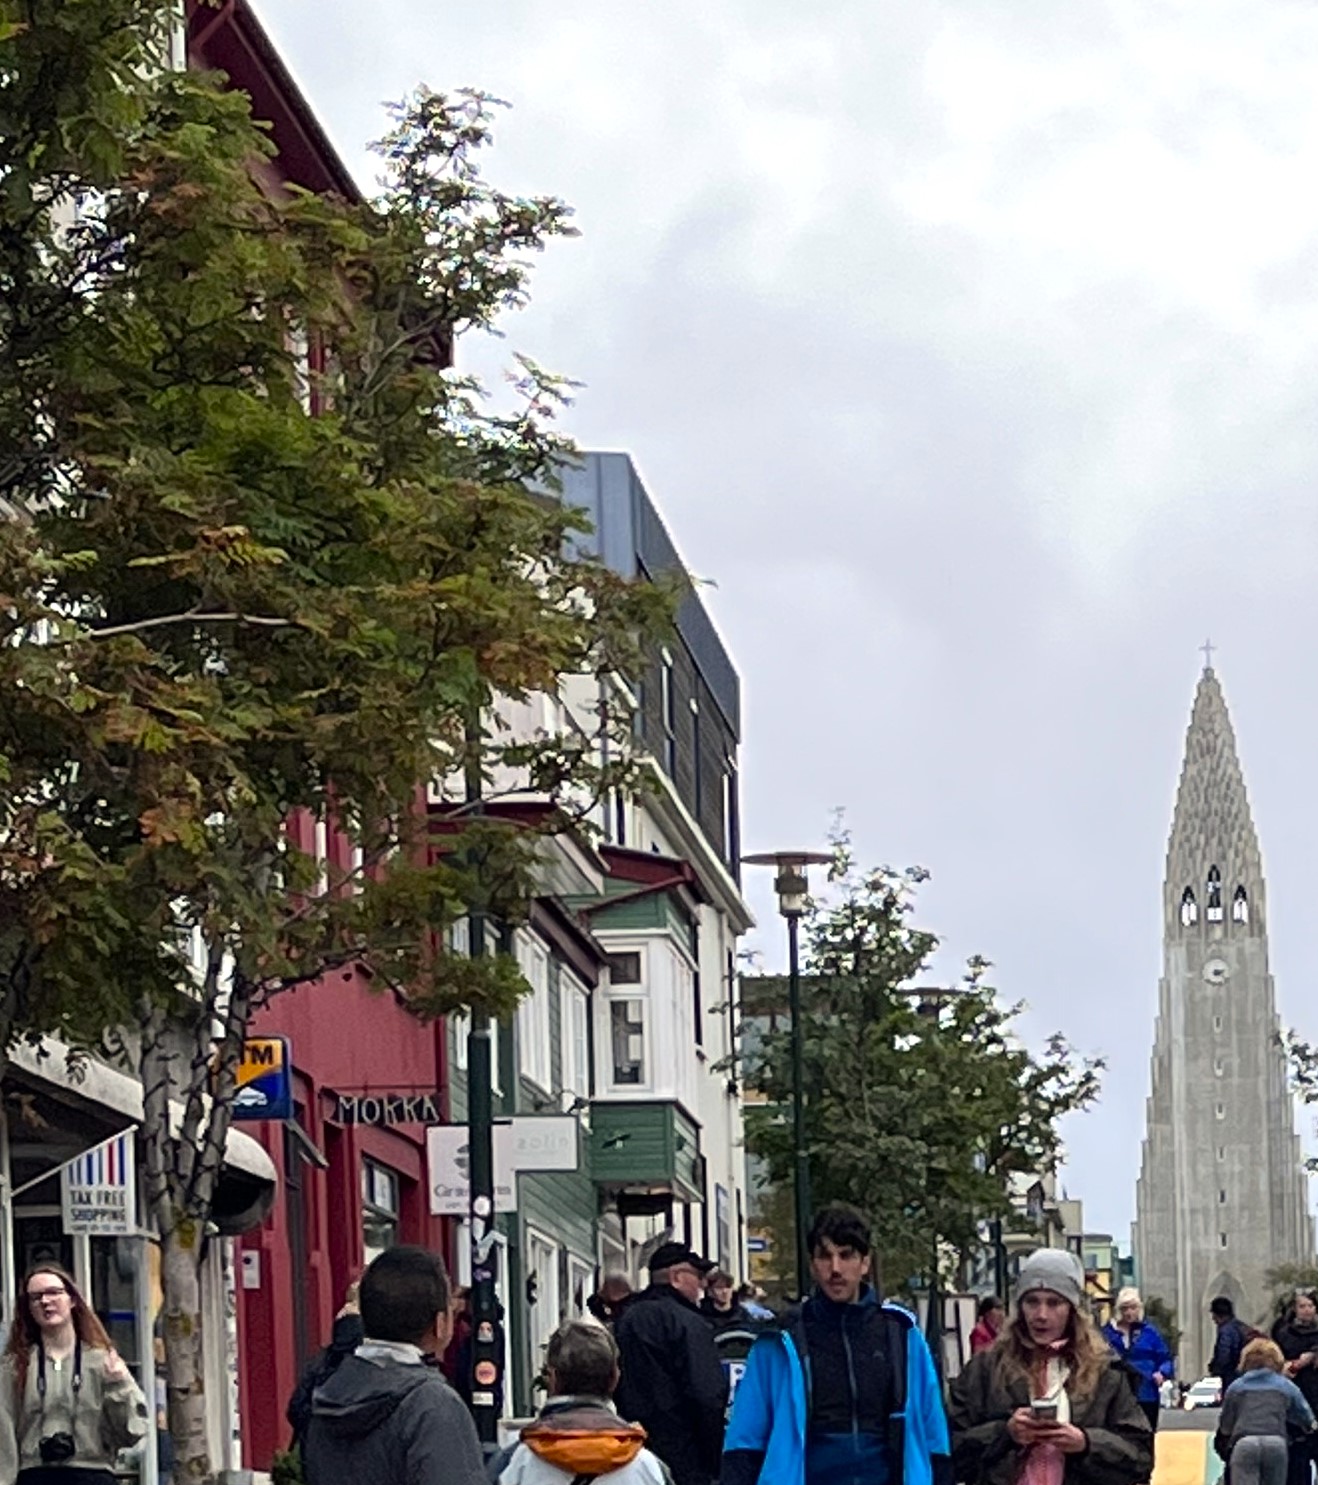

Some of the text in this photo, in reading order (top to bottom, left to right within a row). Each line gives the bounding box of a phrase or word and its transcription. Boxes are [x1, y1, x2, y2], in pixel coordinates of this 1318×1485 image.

[337, 1095, 440, 1126] MOKKA
[69, 1190, 126, 1206] TAX FREE
[70, 1208, 126, 1221] SHOPPING
